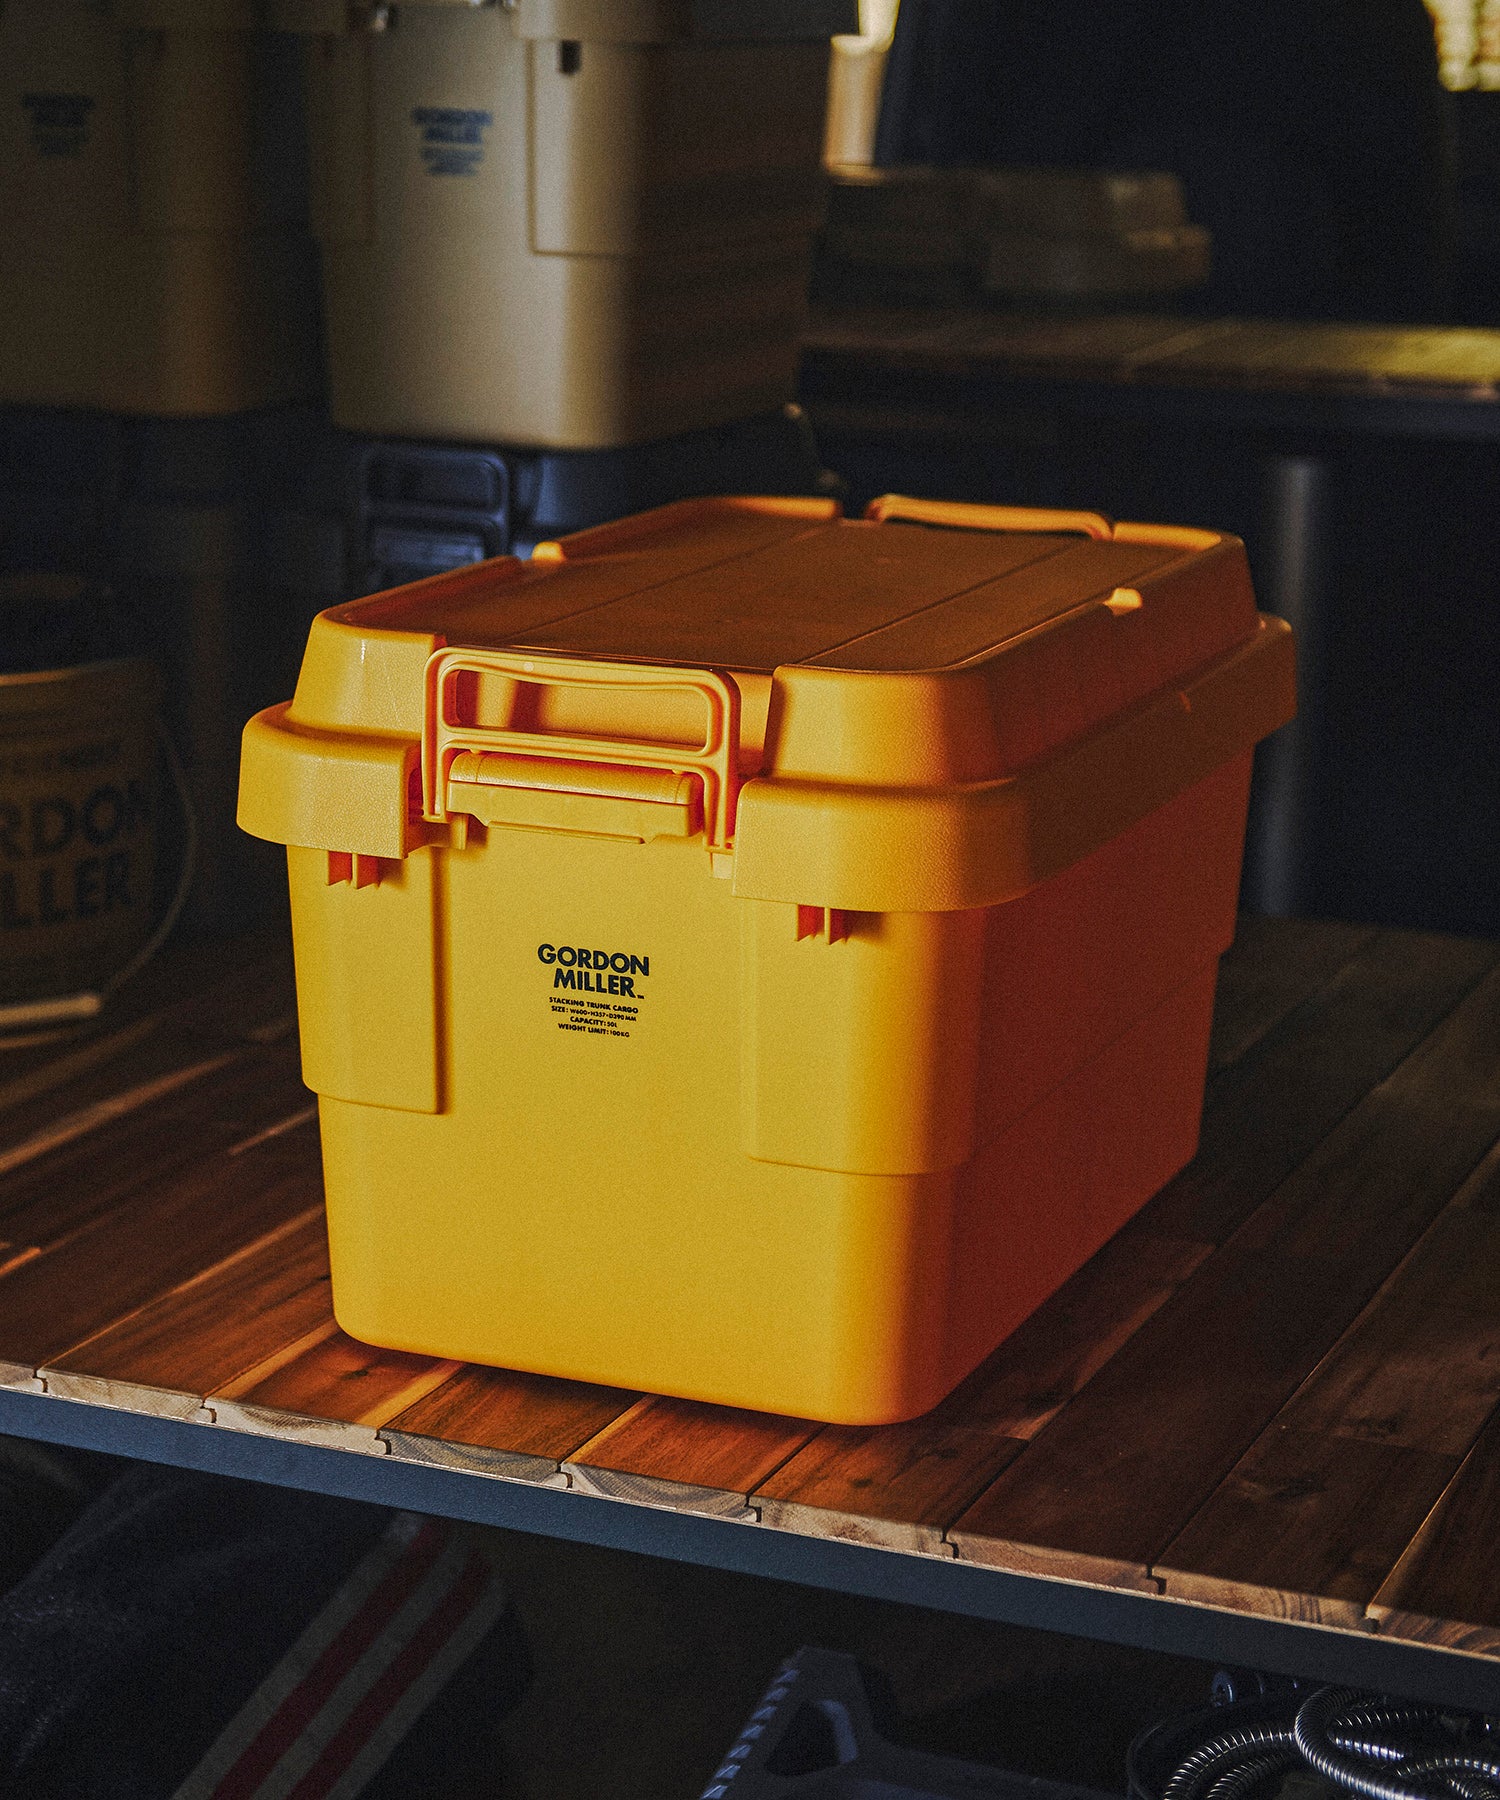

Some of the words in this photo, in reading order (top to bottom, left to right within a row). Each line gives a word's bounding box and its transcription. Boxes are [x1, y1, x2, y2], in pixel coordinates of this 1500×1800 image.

[537, 943, 650, 977] GORDON
[549, 996, 585, 1007] STACKING
[586, 1001, 611, 1011] TRUNK
[612, 1005, 639, 1014] CARGO
[557, 1022, 586, 1032] WEIGHT
